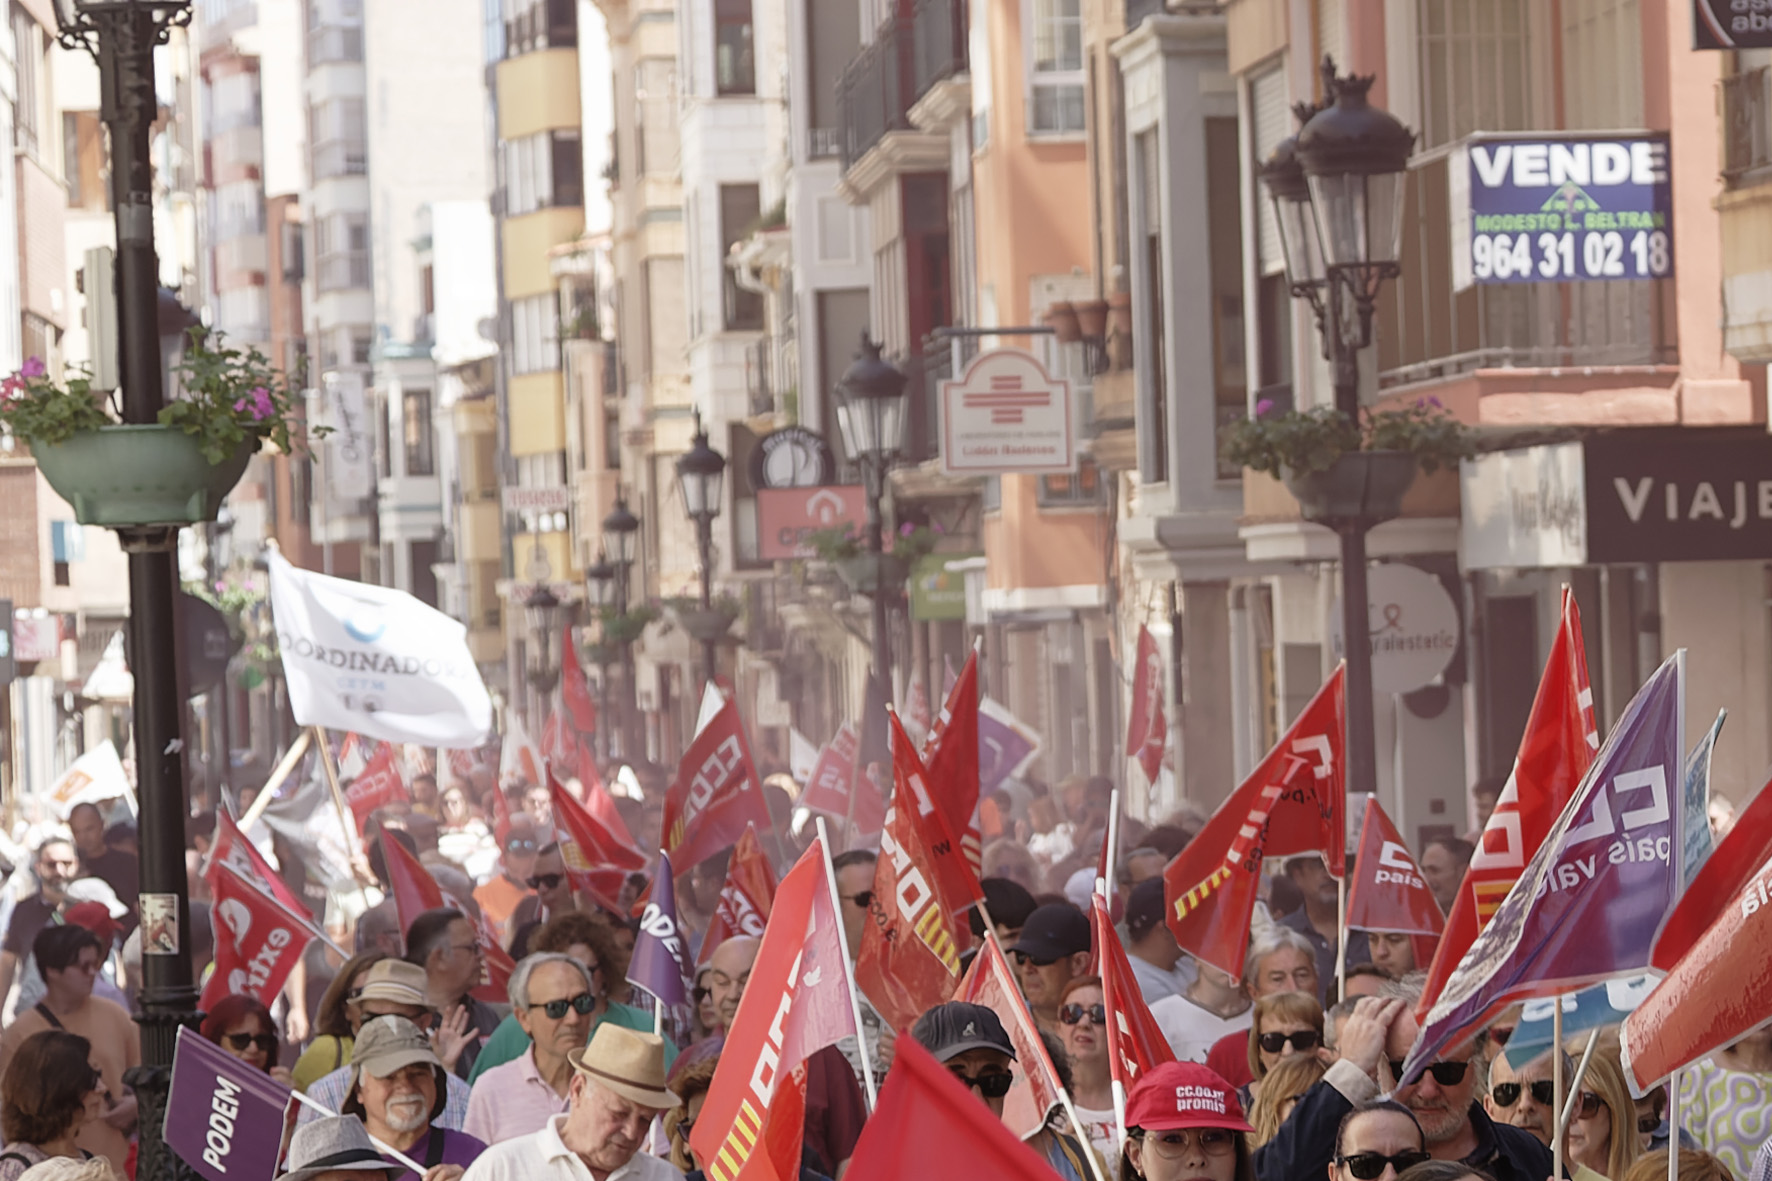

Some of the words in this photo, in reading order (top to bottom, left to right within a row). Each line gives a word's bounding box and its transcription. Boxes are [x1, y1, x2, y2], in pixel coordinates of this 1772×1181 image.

[1471, 142, 1668, 188] VENDE
[1475, 212, 1562, 232] MODESTO
[1473, 232, 1533, 279] 964
[1538, 231, 1576, 278] 31
[1583, 230, 1626, 277] 02
[1630, 230, 1670, 277] 18
[1375, 868, 1424, 890] país
[202, 1074, 242, 1174] PODEM
